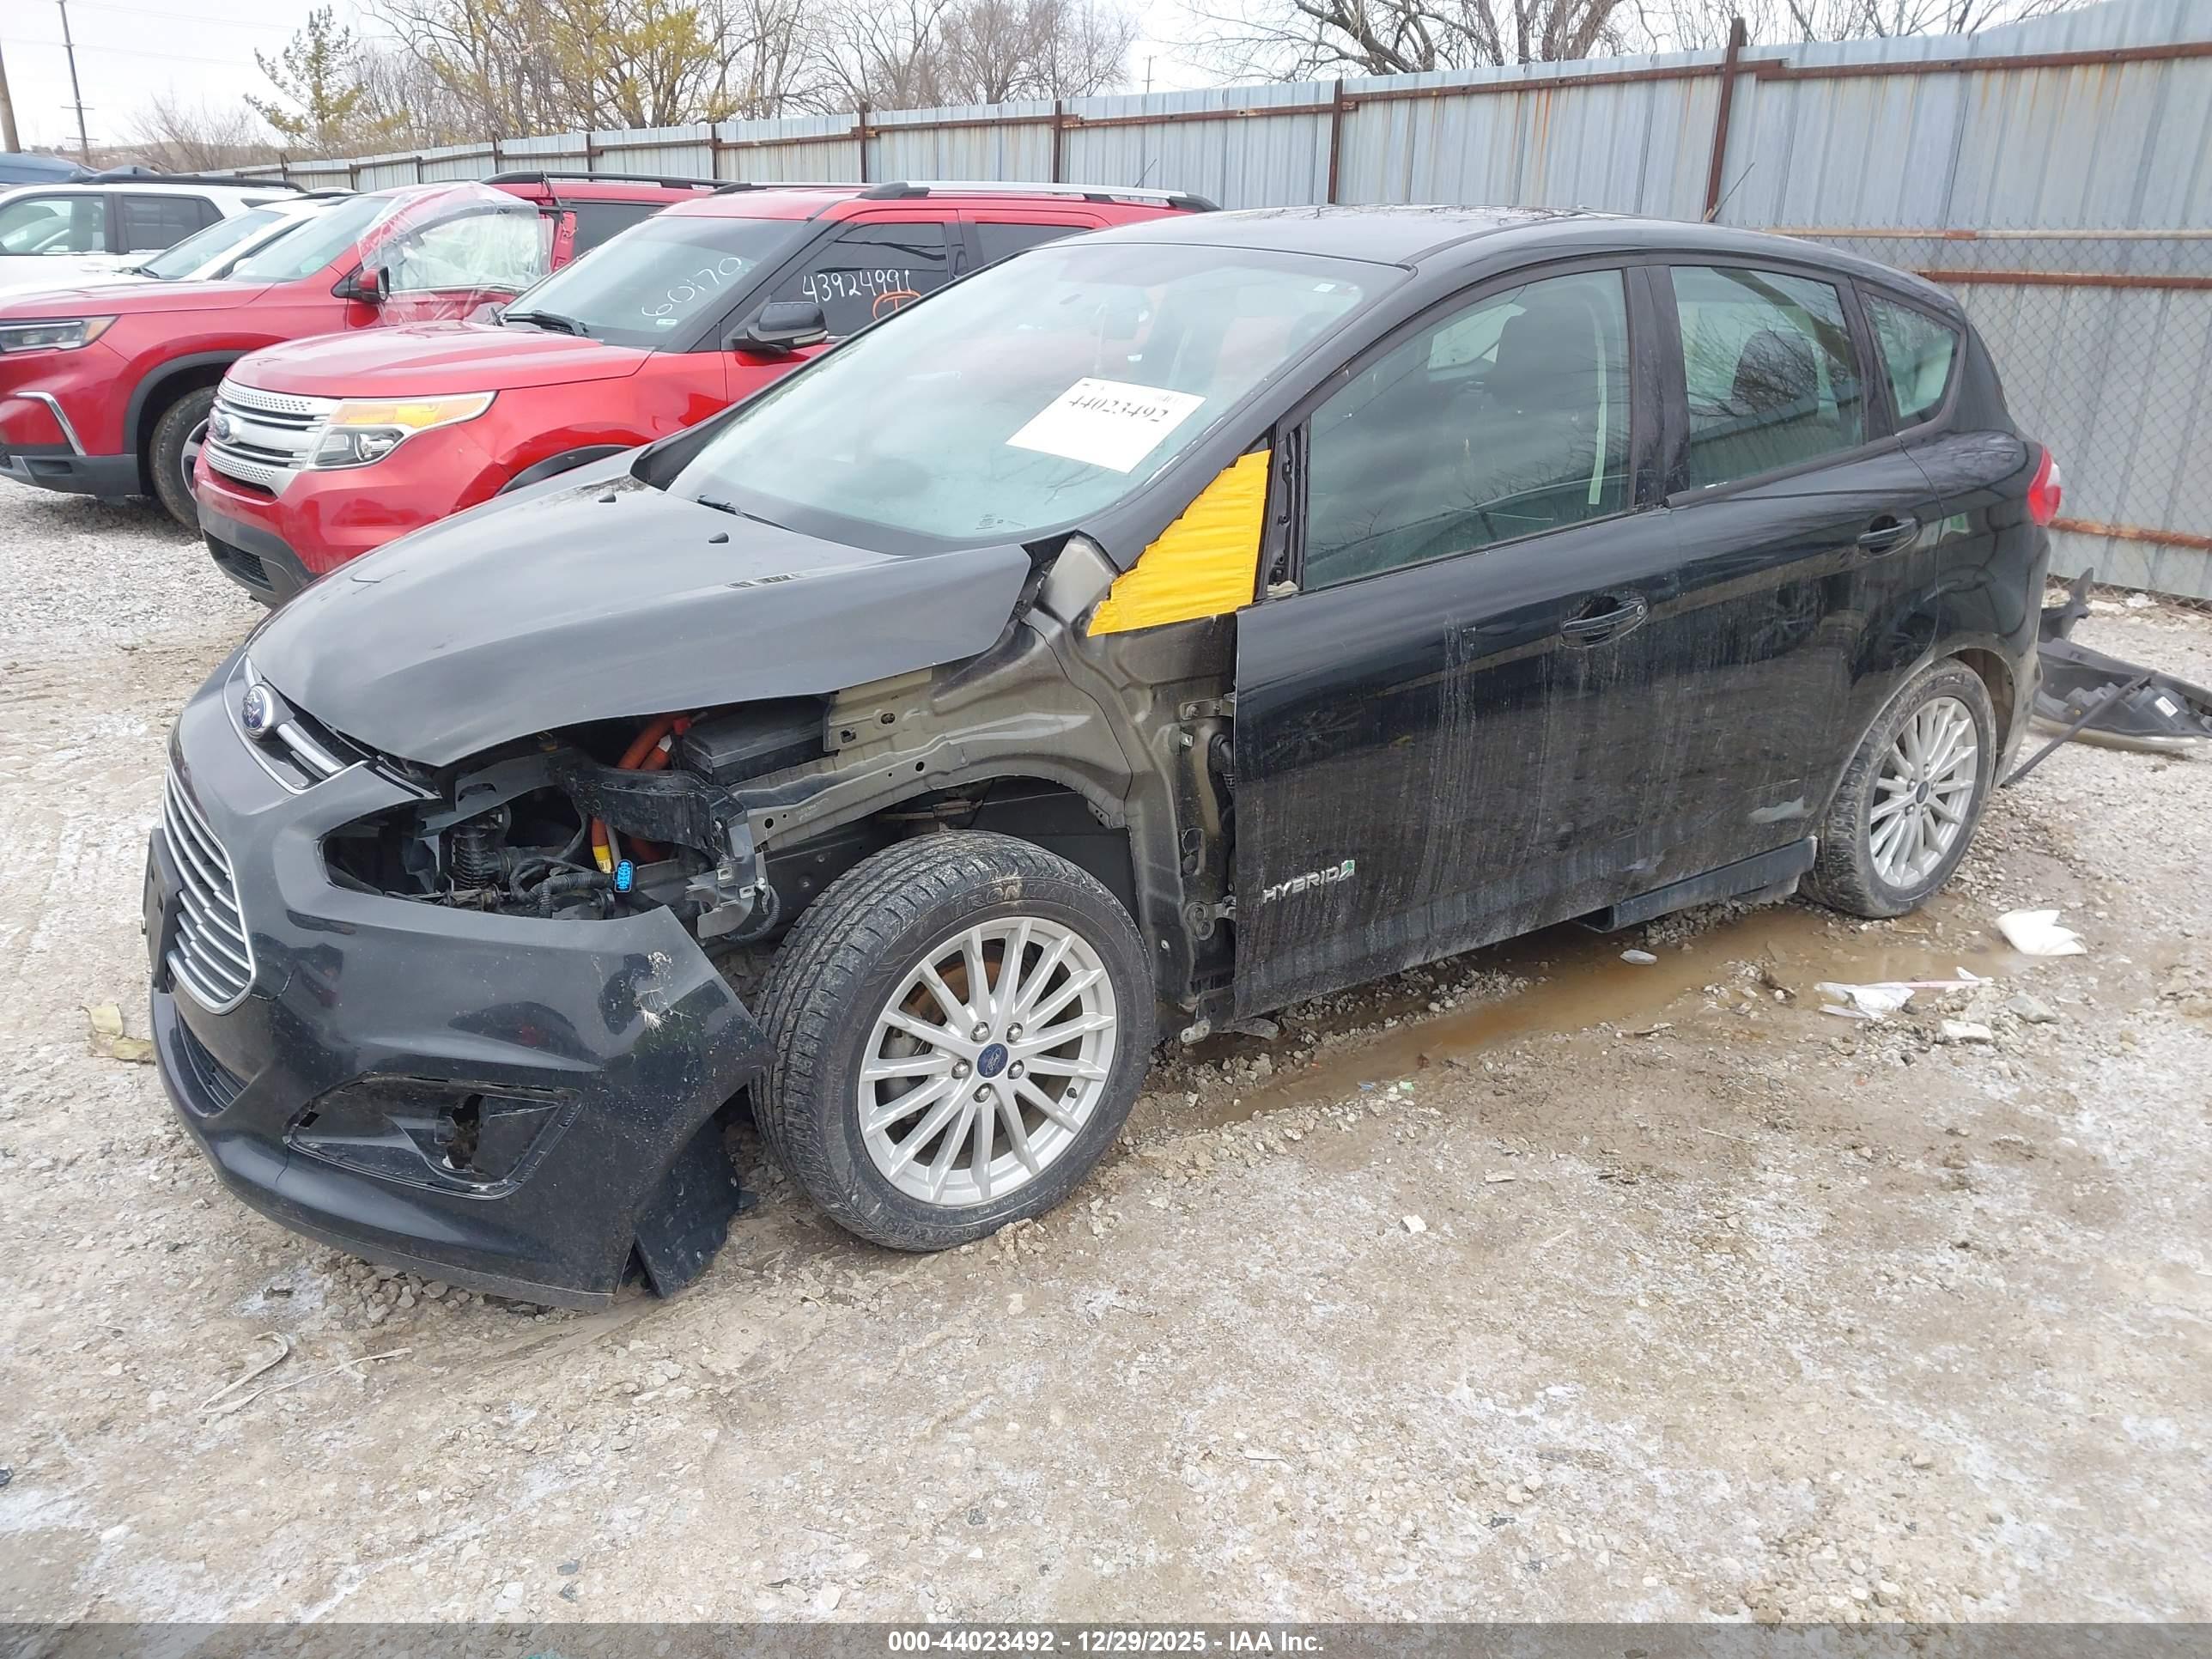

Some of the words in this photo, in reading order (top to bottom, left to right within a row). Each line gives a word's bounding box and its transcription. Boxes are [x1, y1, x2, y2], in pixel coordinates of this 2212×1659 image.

[641, 257, 742, 316] 60170
[802, 269, 910, 303] 43924991
[1262, 866, 1340, 903] HYBRID
